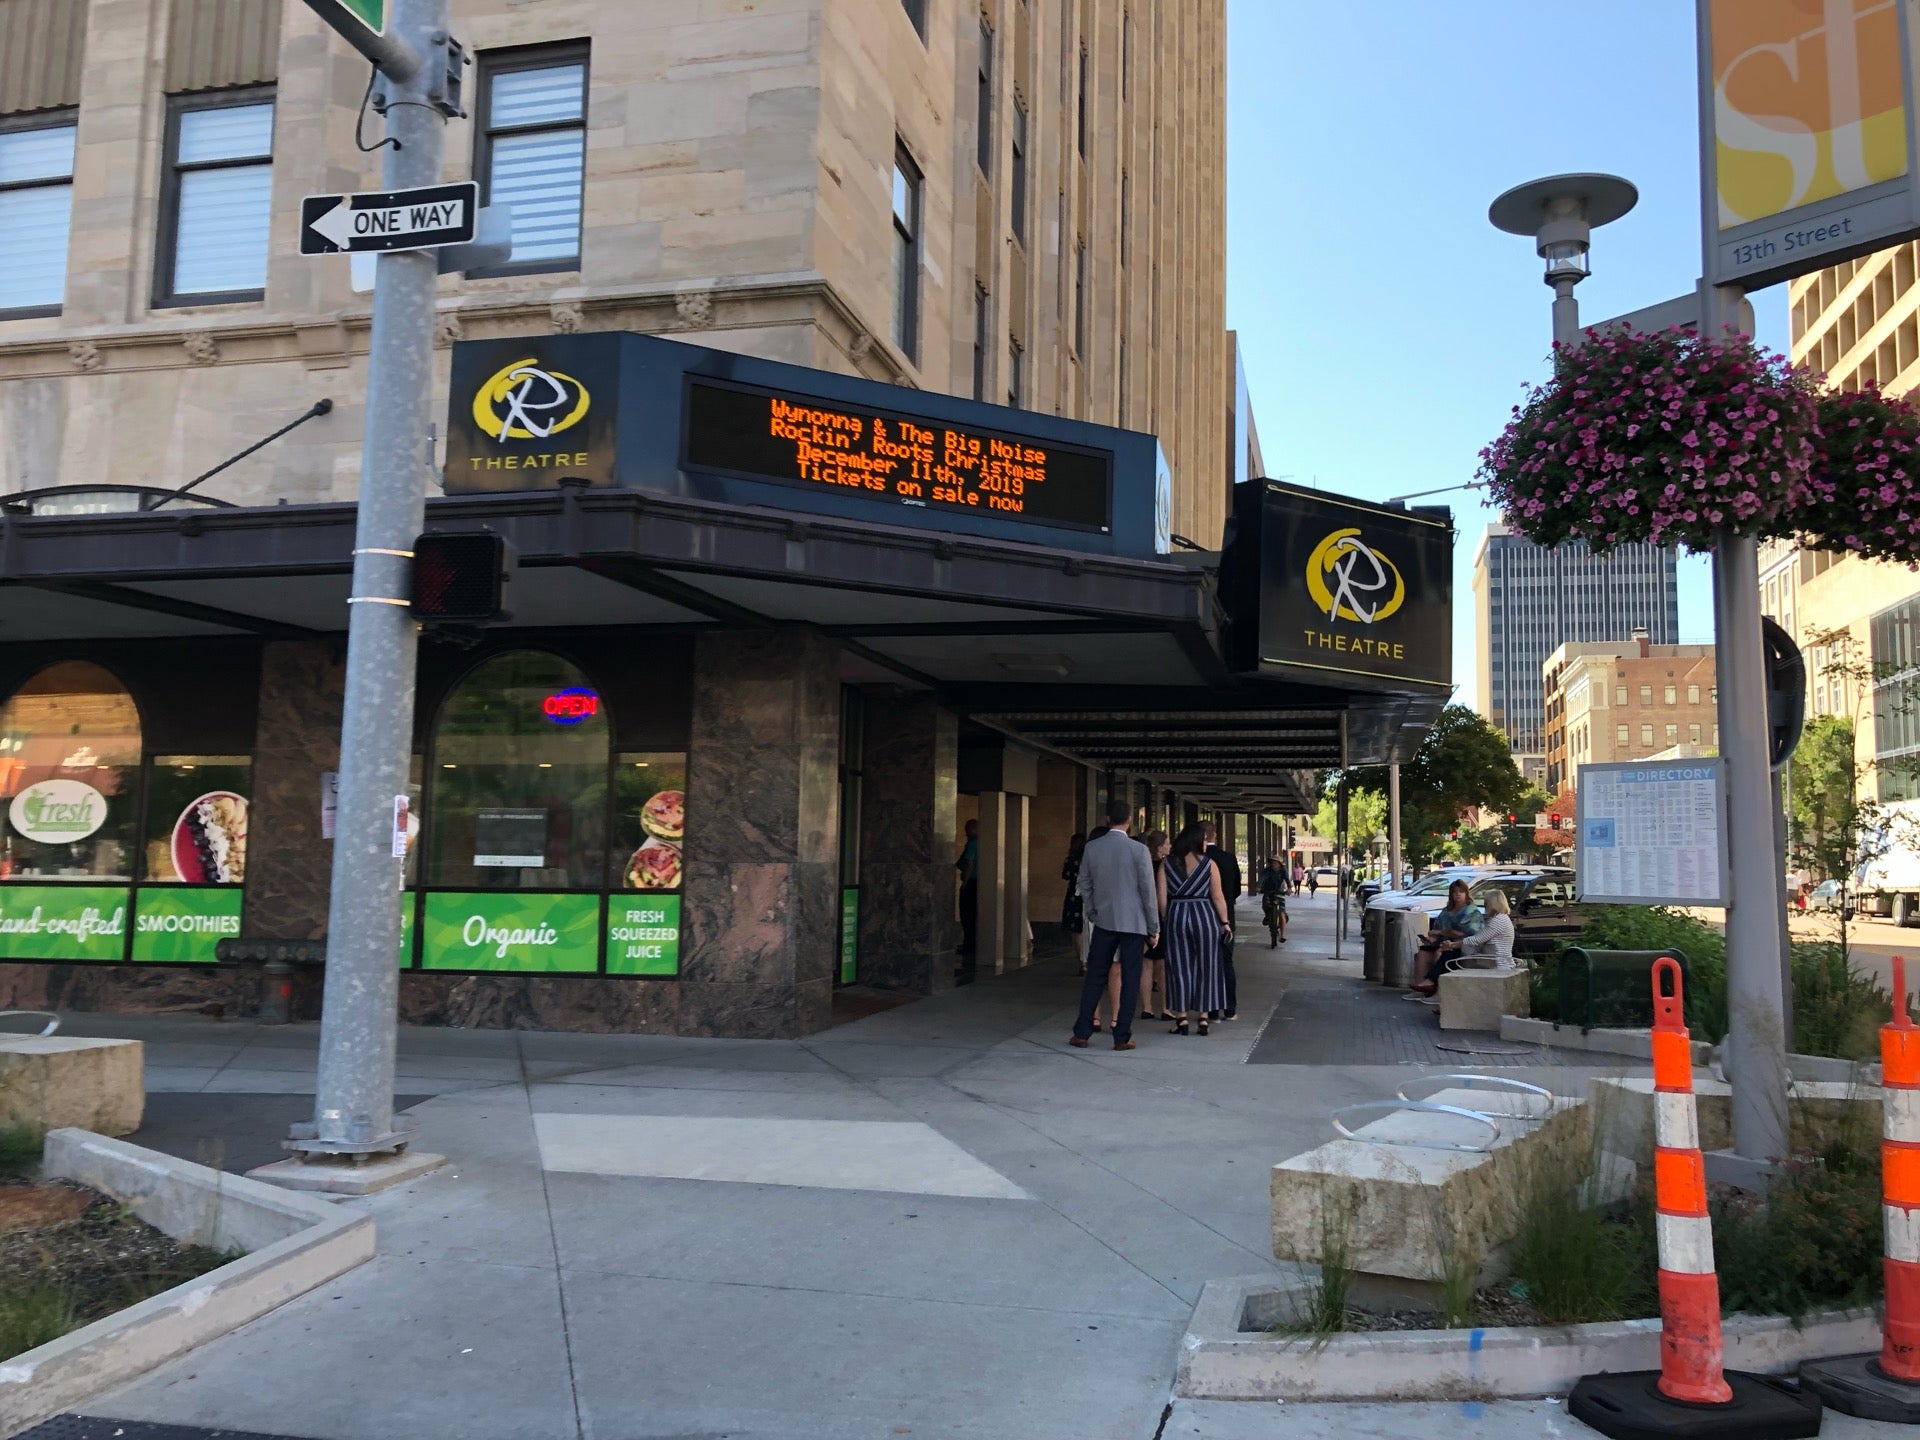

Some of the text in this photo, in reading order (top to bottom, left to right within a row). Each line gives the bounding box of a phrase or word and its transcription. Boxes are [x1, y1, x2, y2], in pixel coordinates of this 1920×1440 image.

[354, 203, 456, 234] ONE WAY
[1732, 217, 1853, 265] 13th Street
[771, 399, 1046, 464] Wynonna & The Big Noise
[470, 452, 589, 471] THEATRE
[771, 418, 1046, 481] Rockin' Roots Christmas
[797, 441, 1024, 495] December 11th, 2019
[797, 459, 885, 491] Tickets
[897, 480, 921, 496] on
[932, 486, 979, 505] sale
[989, 495, 1023, 512] now
[1304, 630, 1404, 659] THEATRE
[543, 696, 598, 715] OPEN
[1637, 768, 1711, 781] DIRECTORY
[0, 905, 124, 943] and-crafted
[137, 915, 240, 933] SMOOTHIES
[625, 910, 665, 923] FRESH
[462, 915, 558, 958] Organic
[611, 927, 678, 941] SQUEEZED
[625, 946, 662, 958] JUICE
